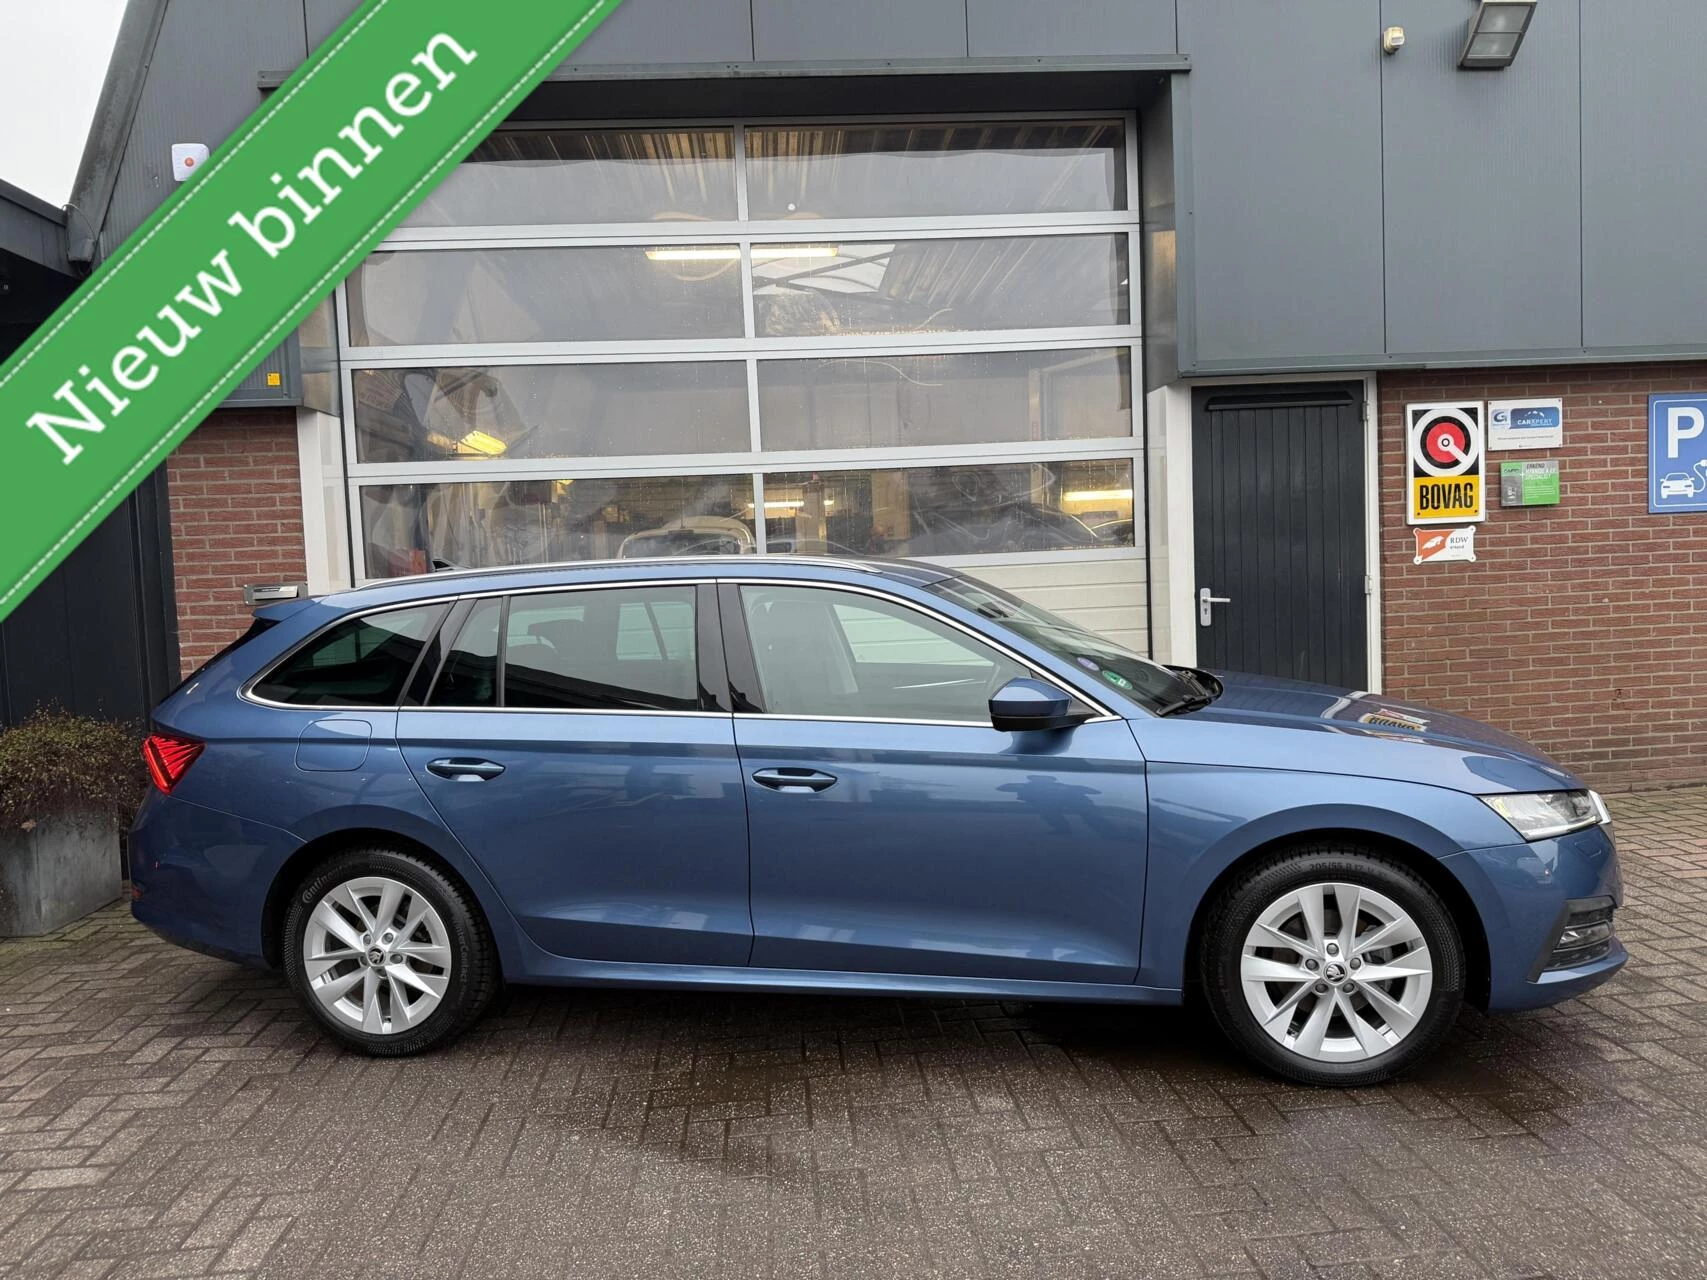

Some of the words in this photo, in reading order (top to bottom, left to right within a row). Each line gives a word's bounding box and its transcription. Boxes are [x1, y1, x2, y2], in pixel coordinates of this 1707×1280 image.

[1668, 407, 1705, 458] P
[1419, 482, 1474, 511] BOVAG
[1450, 536, 1469, 544] RDW
